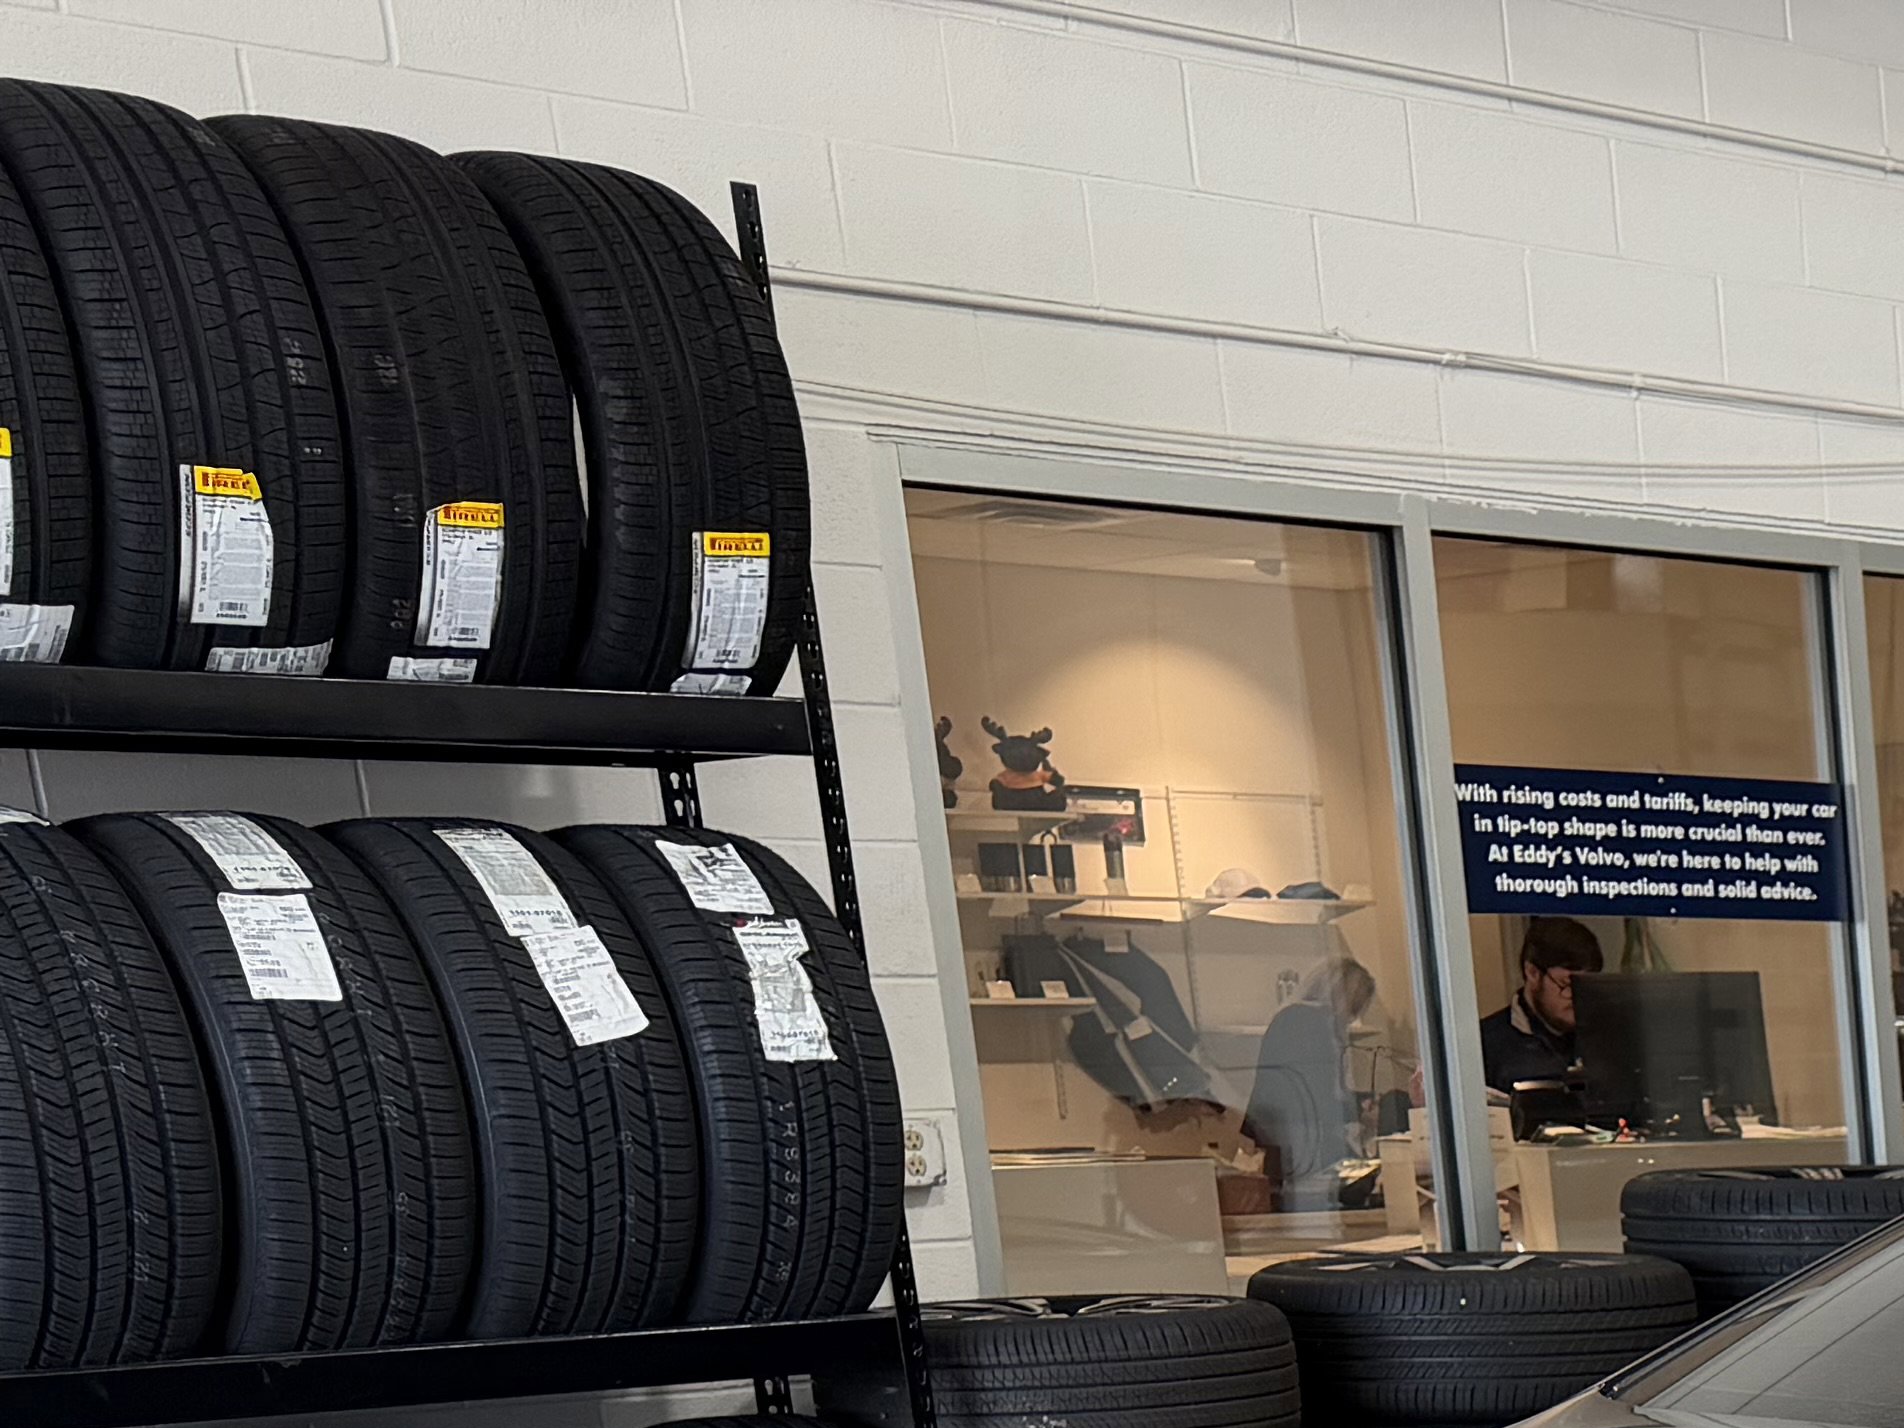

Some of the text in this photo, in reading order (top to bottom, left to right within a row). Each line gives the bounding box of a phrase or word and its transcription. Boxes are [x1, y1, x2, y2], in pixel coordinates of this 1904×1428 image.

[1454, 783, 1837, 820] With rising costs and tariffs, keeping your car
[1473, 813, 1826, 846] in tip-top shape is more crucial than ever.
[1488, 844, 1508, 862] At
[1575, 847, 1630, 869] Volvo,
[1682, 850, 1721, 869] here
[1724, 853, 1741, 870] to
[1744, 852, 1781, 875] help
[1784, 854, 1819, 873] with
[1495, 873, 1818, 901] thorough inspections and solid advice.
